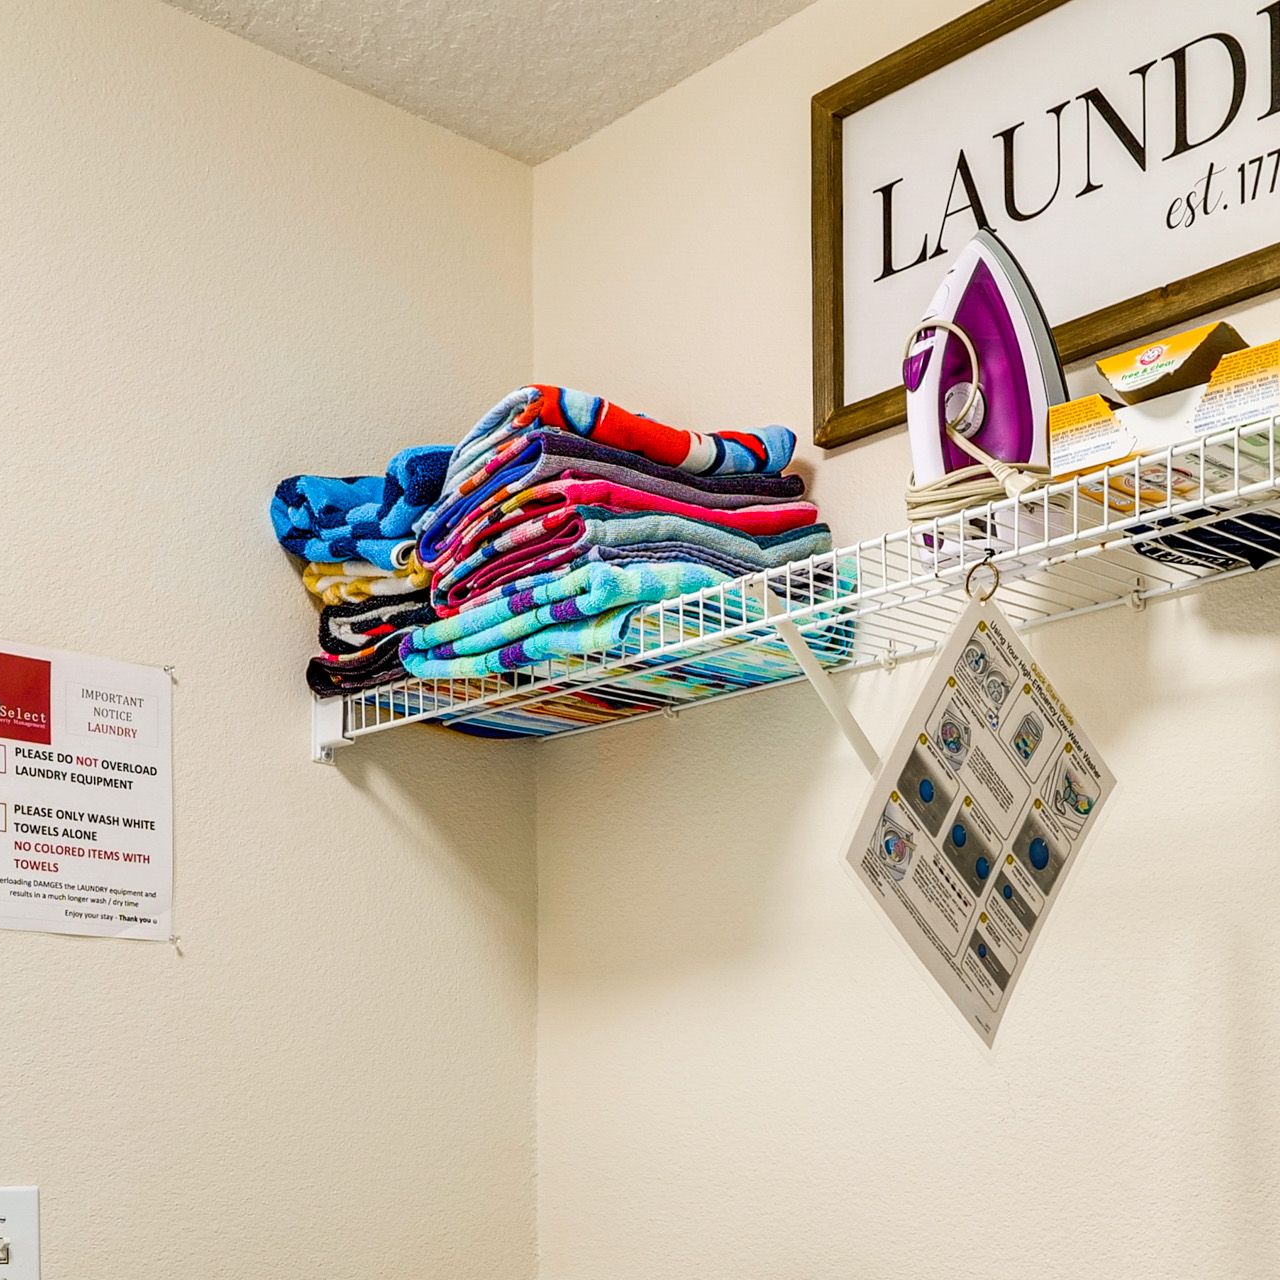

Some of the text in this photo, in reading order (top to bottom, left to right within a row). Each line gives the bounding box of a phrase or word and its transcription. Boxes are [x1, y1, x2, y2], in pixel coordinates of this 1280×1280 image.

[1166, 162, 1227, 230] est.
[1122, 371, 1139, 380] free
[1150, 360, 1175, 370] clear
[81, 688, 144, 708] IMPORTANT
[990, 621, 1006, 646] Using
[1007, 642, 1023, 662] Your
[1019, 660, 1058, 717] High-Efficiency
[1056, 715, 1083, 752] Low-Water
[1083, 752, 1101, 780] Washer
[1031, 662, 1046, 687] Quick
[1045, 682, 1059, 704] Start
[1059, 703, 1074, 726] Guide
[0, 705, 47, 723] Select
[93, 707, 133, 722] NOTICE
[87, 722, 138, 738] LAUNDRY
[15, 747, 54, 762] PLEASE
[57, 754, 73, 765] DO
[76, 756, 99, 768] NOT
[101, 760, 157, 776] OVERLOAD
[15, 765, 133, 790] LAUNDRY EQUIPMENT
[14, 804, 53, 819] PLEASE
[55, 809, 85, 822] ONLY
[88, 813, 120, 826] WASH
[122, 817, 155, 831] WHITE
[14, 822, 98, 841] TOWELS ALONE
[14, 841, 150, 864] NO COLORED ITEMS WITH
[14, 858, 59, 873] TOWELS
[9, 890, 33, 898] results
[48, 893, 67, 901] much
[68, 895, 88, 904] longer
[90, 896, 106, 904] wash
[112, 898, 123, 908] dry
[124, 900, 139, 908] time
[64, 882, 75, 891] the
[77, 884, 108, 894] LAUNDRY
[109, 888, 143, 898] equipment
[144, 890, 157, 898] and
[64, 909, 83, 919] Enjoy
[84, 912, 99, 920] your
[100, 913, 113, 921] stay
[119, 914, 138, 923] Thank
